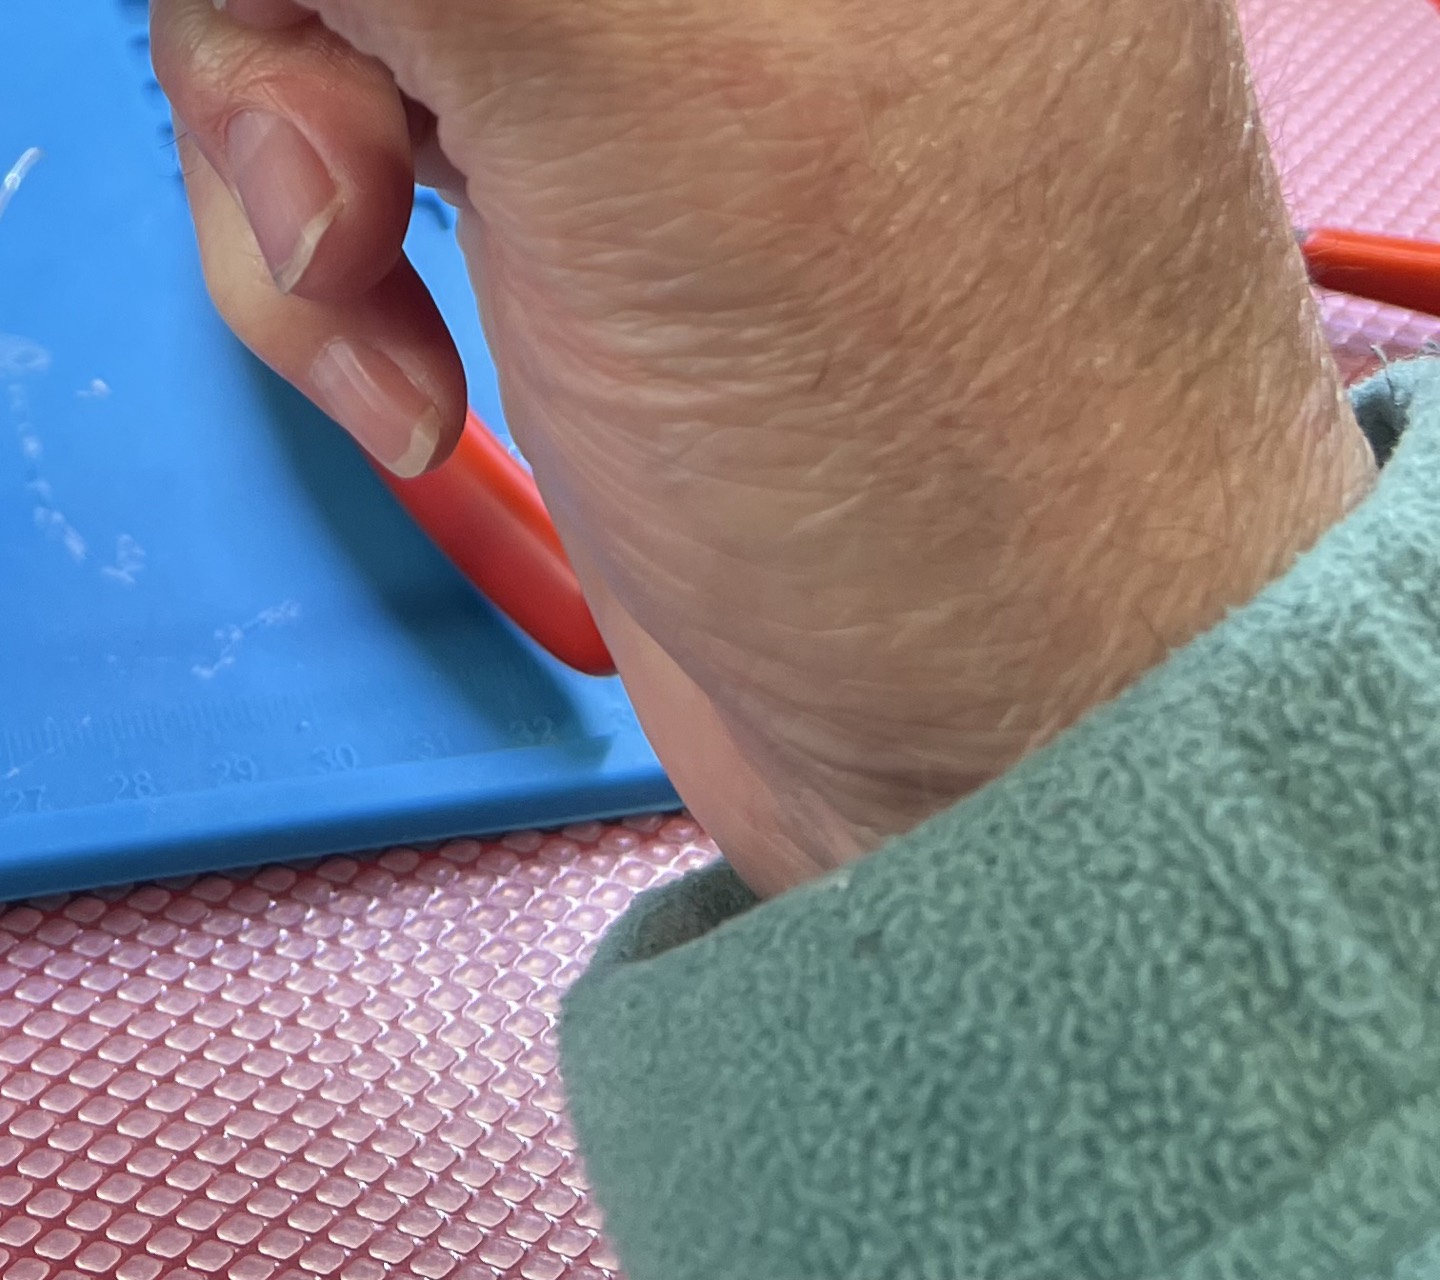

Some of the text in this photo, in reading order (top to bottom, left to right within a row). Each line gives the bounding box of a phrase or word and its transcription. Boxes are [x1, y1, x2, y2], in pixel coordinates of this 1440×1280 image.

[4, 784, 48, 814] 27
[108, 770, 157, 800] 28
[211, 755, 258, 785] 29
[312, 743, 360, 772] 30
